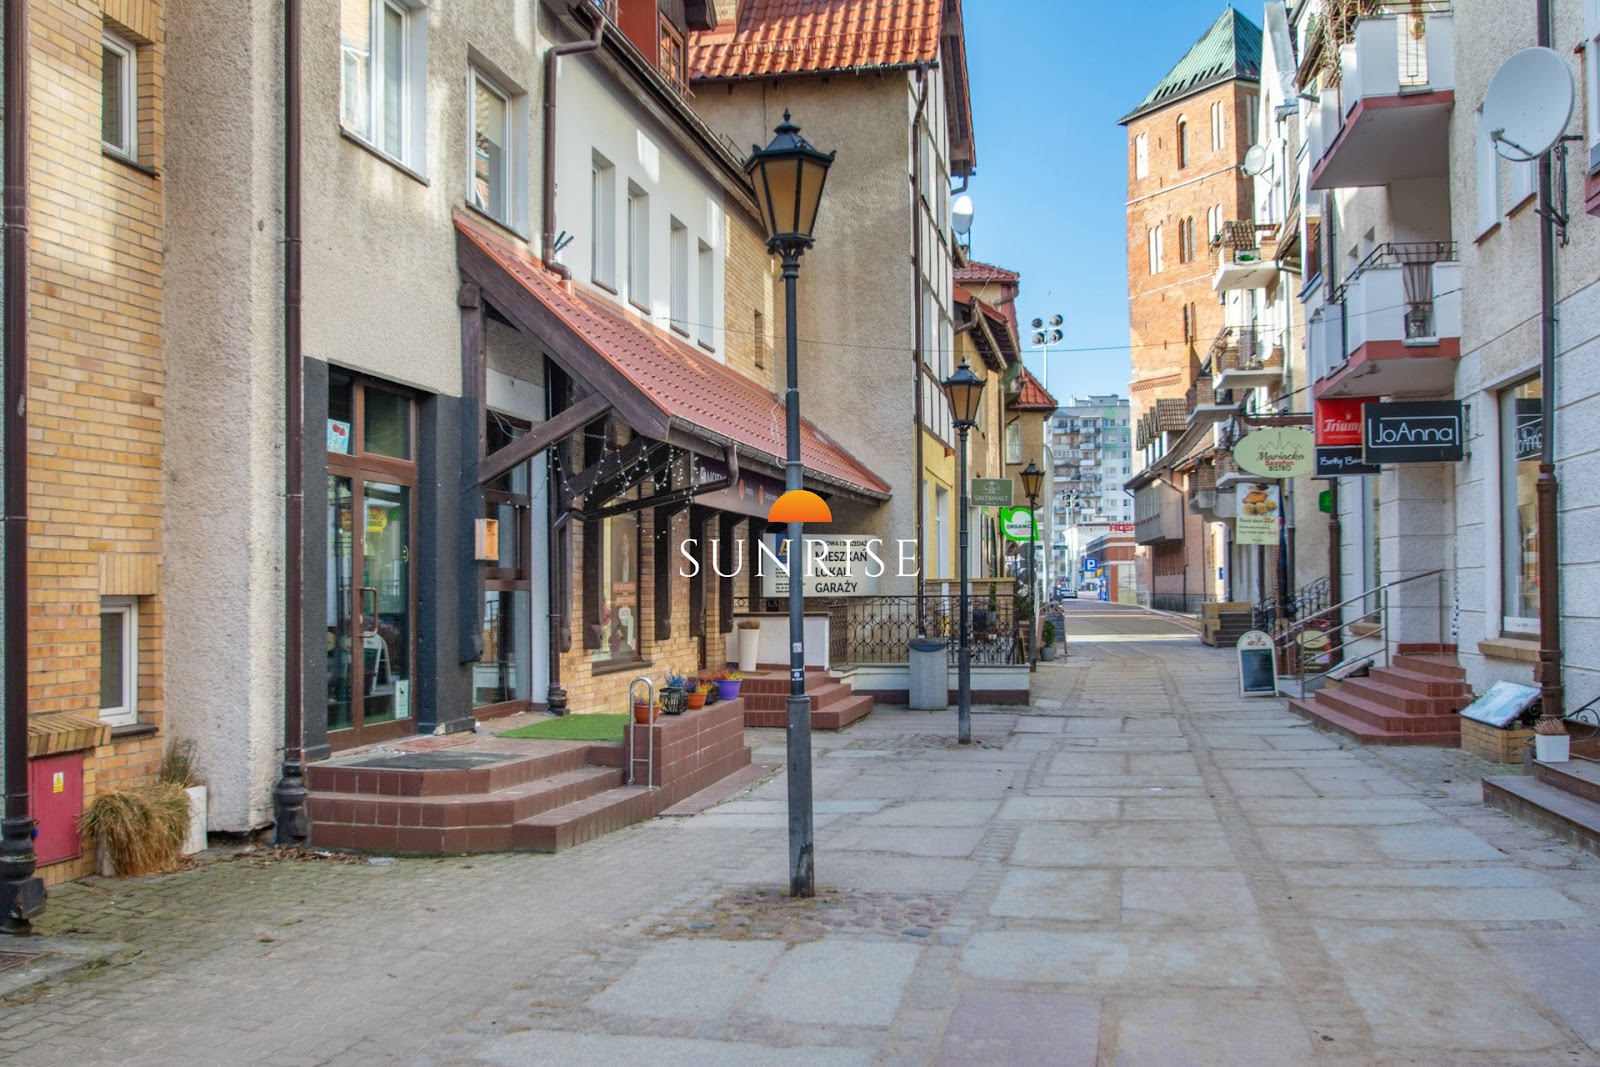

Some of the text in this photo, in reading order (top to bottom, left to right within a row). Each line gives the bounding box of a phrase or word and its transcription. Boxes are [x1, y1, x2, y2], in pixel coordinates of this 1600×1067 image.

[1375, 422, 1453, 443] JoAnna
[1256, 450, 1304, 461] Mariacka
[1087, 560, 1096, 570] P
[815, 580, 858, 593] GARAŻY
